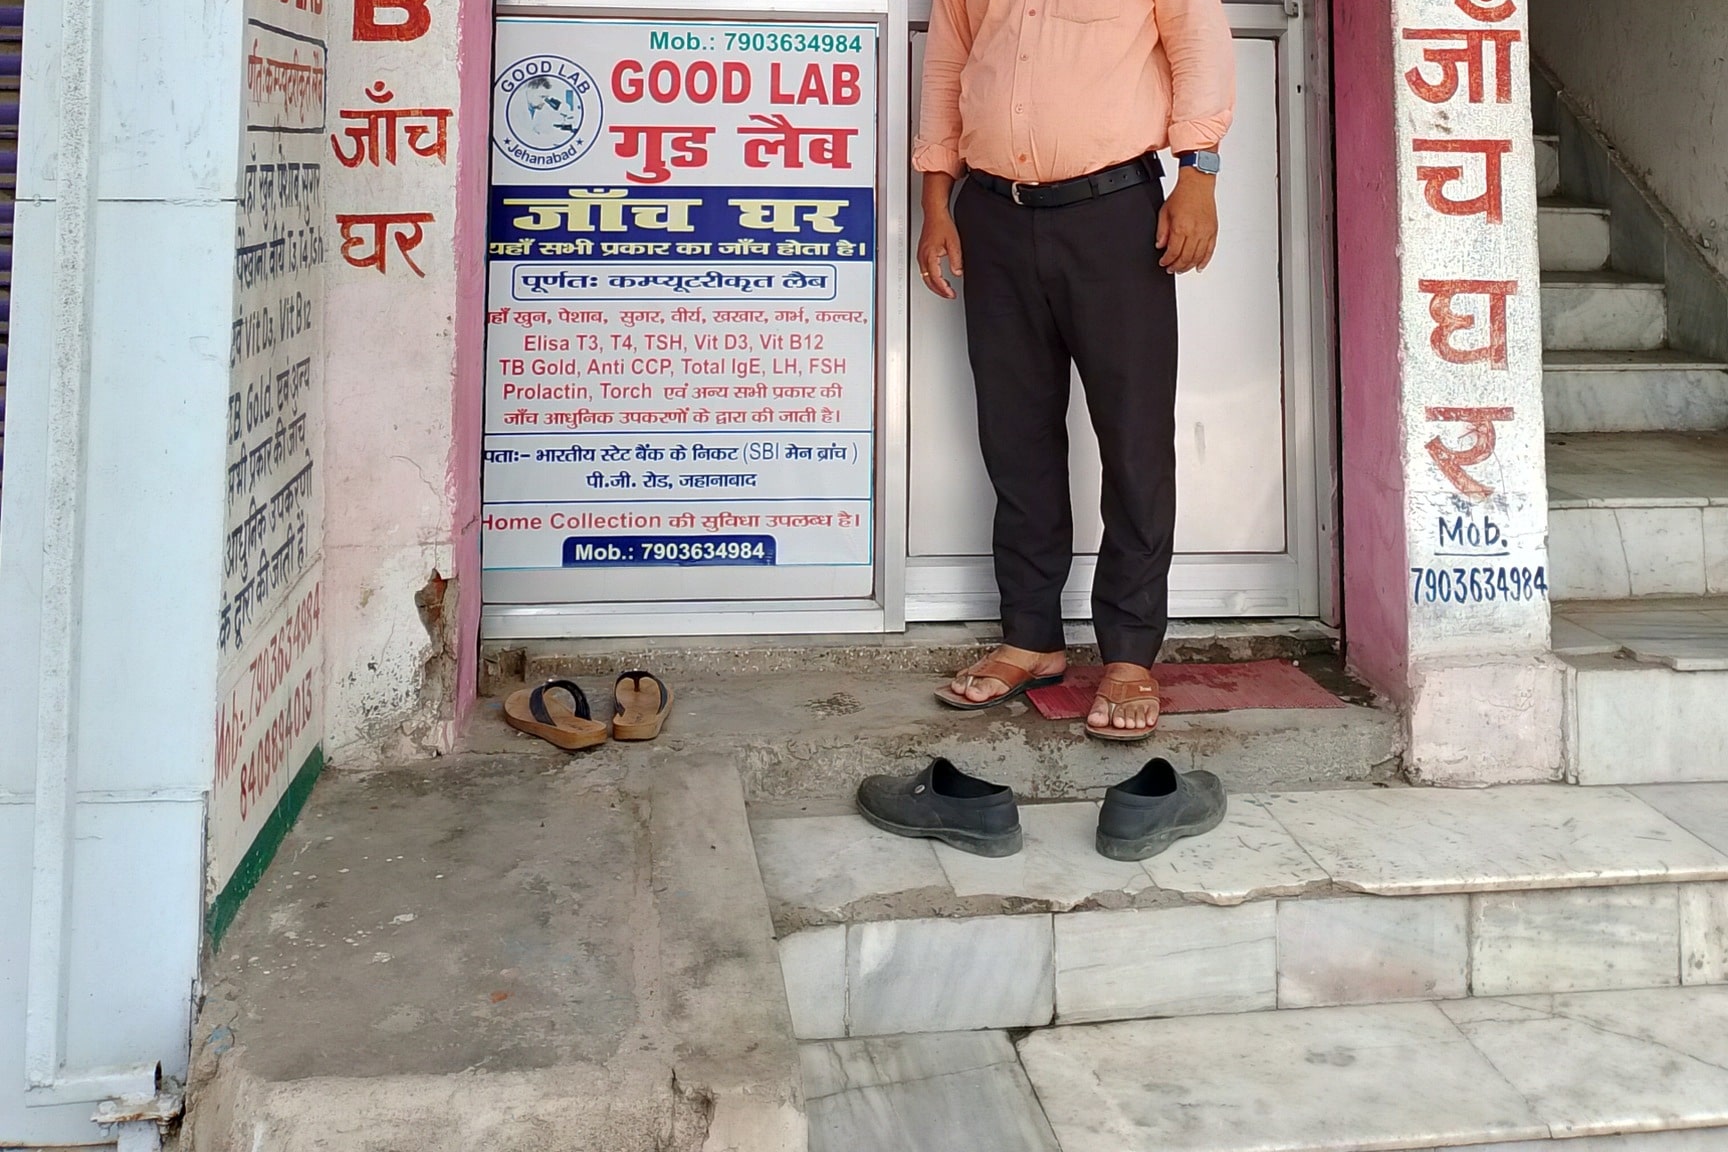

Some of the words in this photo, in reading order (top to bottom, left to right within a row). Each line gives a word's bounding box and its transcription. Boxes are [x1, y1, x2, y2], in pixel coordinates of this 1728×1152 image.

[724, 32, 862, 53] 7903634984
[500, 60, 552, 94] GOOD
[557, 63, 591, 95] LAB
[610, 58, 752, 105] GOOD
[769, 61, 862, 106] LAB
[330, 80, 454, 169] जाँच
[507, 143, 578, 165] Jehanabad
[608, 125, 716, 184] गुड
[736, 113, 859, 169] लैब
[502, 188, 703, 233] जाँच
[727, 198, 850, 234] घर
[335, 211, 436, 279] घर
[488, 237, 536, 256] यहाँ
[537, 238, 595, 256] सभी
[599, 242, 672, 257] प्रकार
[675, 242, 713, 256] का
[718, 238, 771, 256] जाँच
[776, 239, 831, 256] होता
[781, 270, 829, 290] लैब
[513, 311, 552, 328] खुन,
[557, 308, 609, 325] पेशाब,
[619, 310, 666, 328] सुगर,
[671, 307, 707, 325] वीर्य,
[774, 307, 810, 325] गर्भ,
[523, 334, 570, 351] Elisa
[575, 334, 604, 354] T3,
[609, 334, 638, 354] T4,
[644, 334, 688, 353] TSH,
[694, 333, 719, 351] Vit
[724, 333, 753, 353] D3,
[759, 333, 784, 351] Vit
[789, 333, 825, 351] B12
[499, 359, 525, 376] TB
[531, 358, 581, 378] Gold,
[586, 358, 625, 376] Anti
[630, 358, 675, 378] CCP,
[681, 357, 726, 375] Total
[772, 357, 803, 378] LH,
[809, 357, 847, 375] FSH
[503, 382, 593, 402] Prolactin,
[599, 382, 653, 399] Torch
[663, 383, 689, 400] एवं
[691, 385, 729, 399] अन्य
[733, 382, 768, 399] सभी
[772, 385, 817, 400] प्रकार
[820, 382, 843, 399] की
[1417, 278, 1518, 498] घर
[503, 407, 539, 425] जाँच
[543, 407, 615, 429] आधुनिक
[619, 406, 690, 424] उपकरणों
[692, 407, 711, 424] के
[715, 409, 748, 425] द्वारा
[751, 407, 775, 424] की
[778, 406, 818, 424] जाती
[535, 444, 597, 463] भारतीय
[600, 444, 633, 462] स्टेट
[635, 443, 666, 462] बैंक
[669, 444, 688, 462] के
[691, 443, 739, 461] निकट
[784, 443, 813, 461] मेन
[816, 442, 847, 462] ब्रांच
[642, 470, 673, 489] रोड,
[678, 473, 758, 489] जहानाबाद
[482, 513, 542, 531] Home
[549, 512, 662, 530] Collection
[668, 512, 696, 529] की
[701, 511, 761, 533] सुविधा
[766, 514, 833, 529] उपलब्ध
[1437, 515, 1508, 548] Mob.
[641, 542, 765, 560] 7903634984
[1410, 565, 1548, 605] 7903634984
[247, 581, 321, 722] 7903634984
[239, 666, 313, 822] 8409894013
